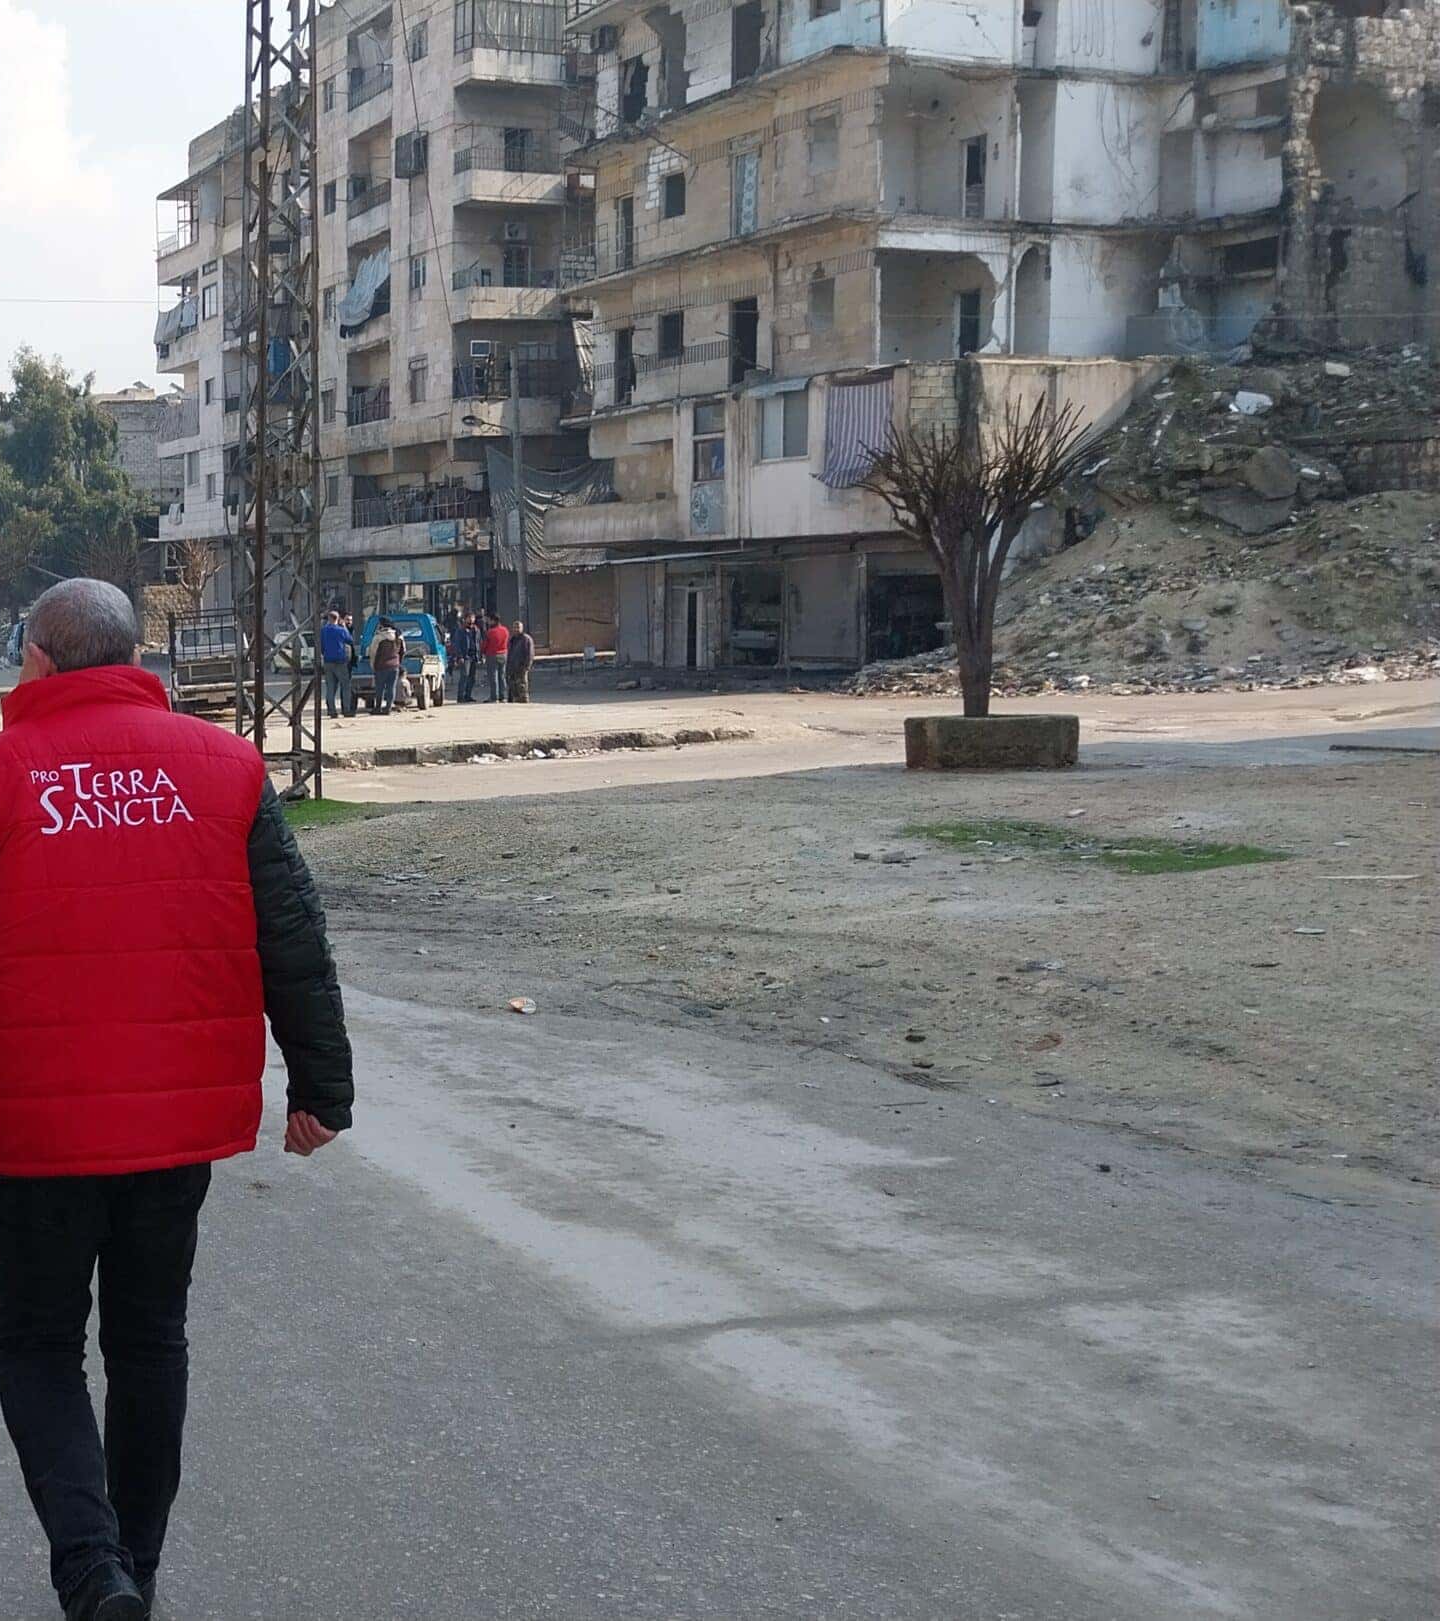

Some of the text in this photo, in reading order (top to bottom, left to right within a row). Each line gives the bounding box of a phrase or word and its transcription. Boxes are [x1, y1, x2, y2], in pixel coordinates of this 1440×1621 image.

[30, 762, 178, 800] PRO TERRA
[39, 785, 195, 835] SANCTA
